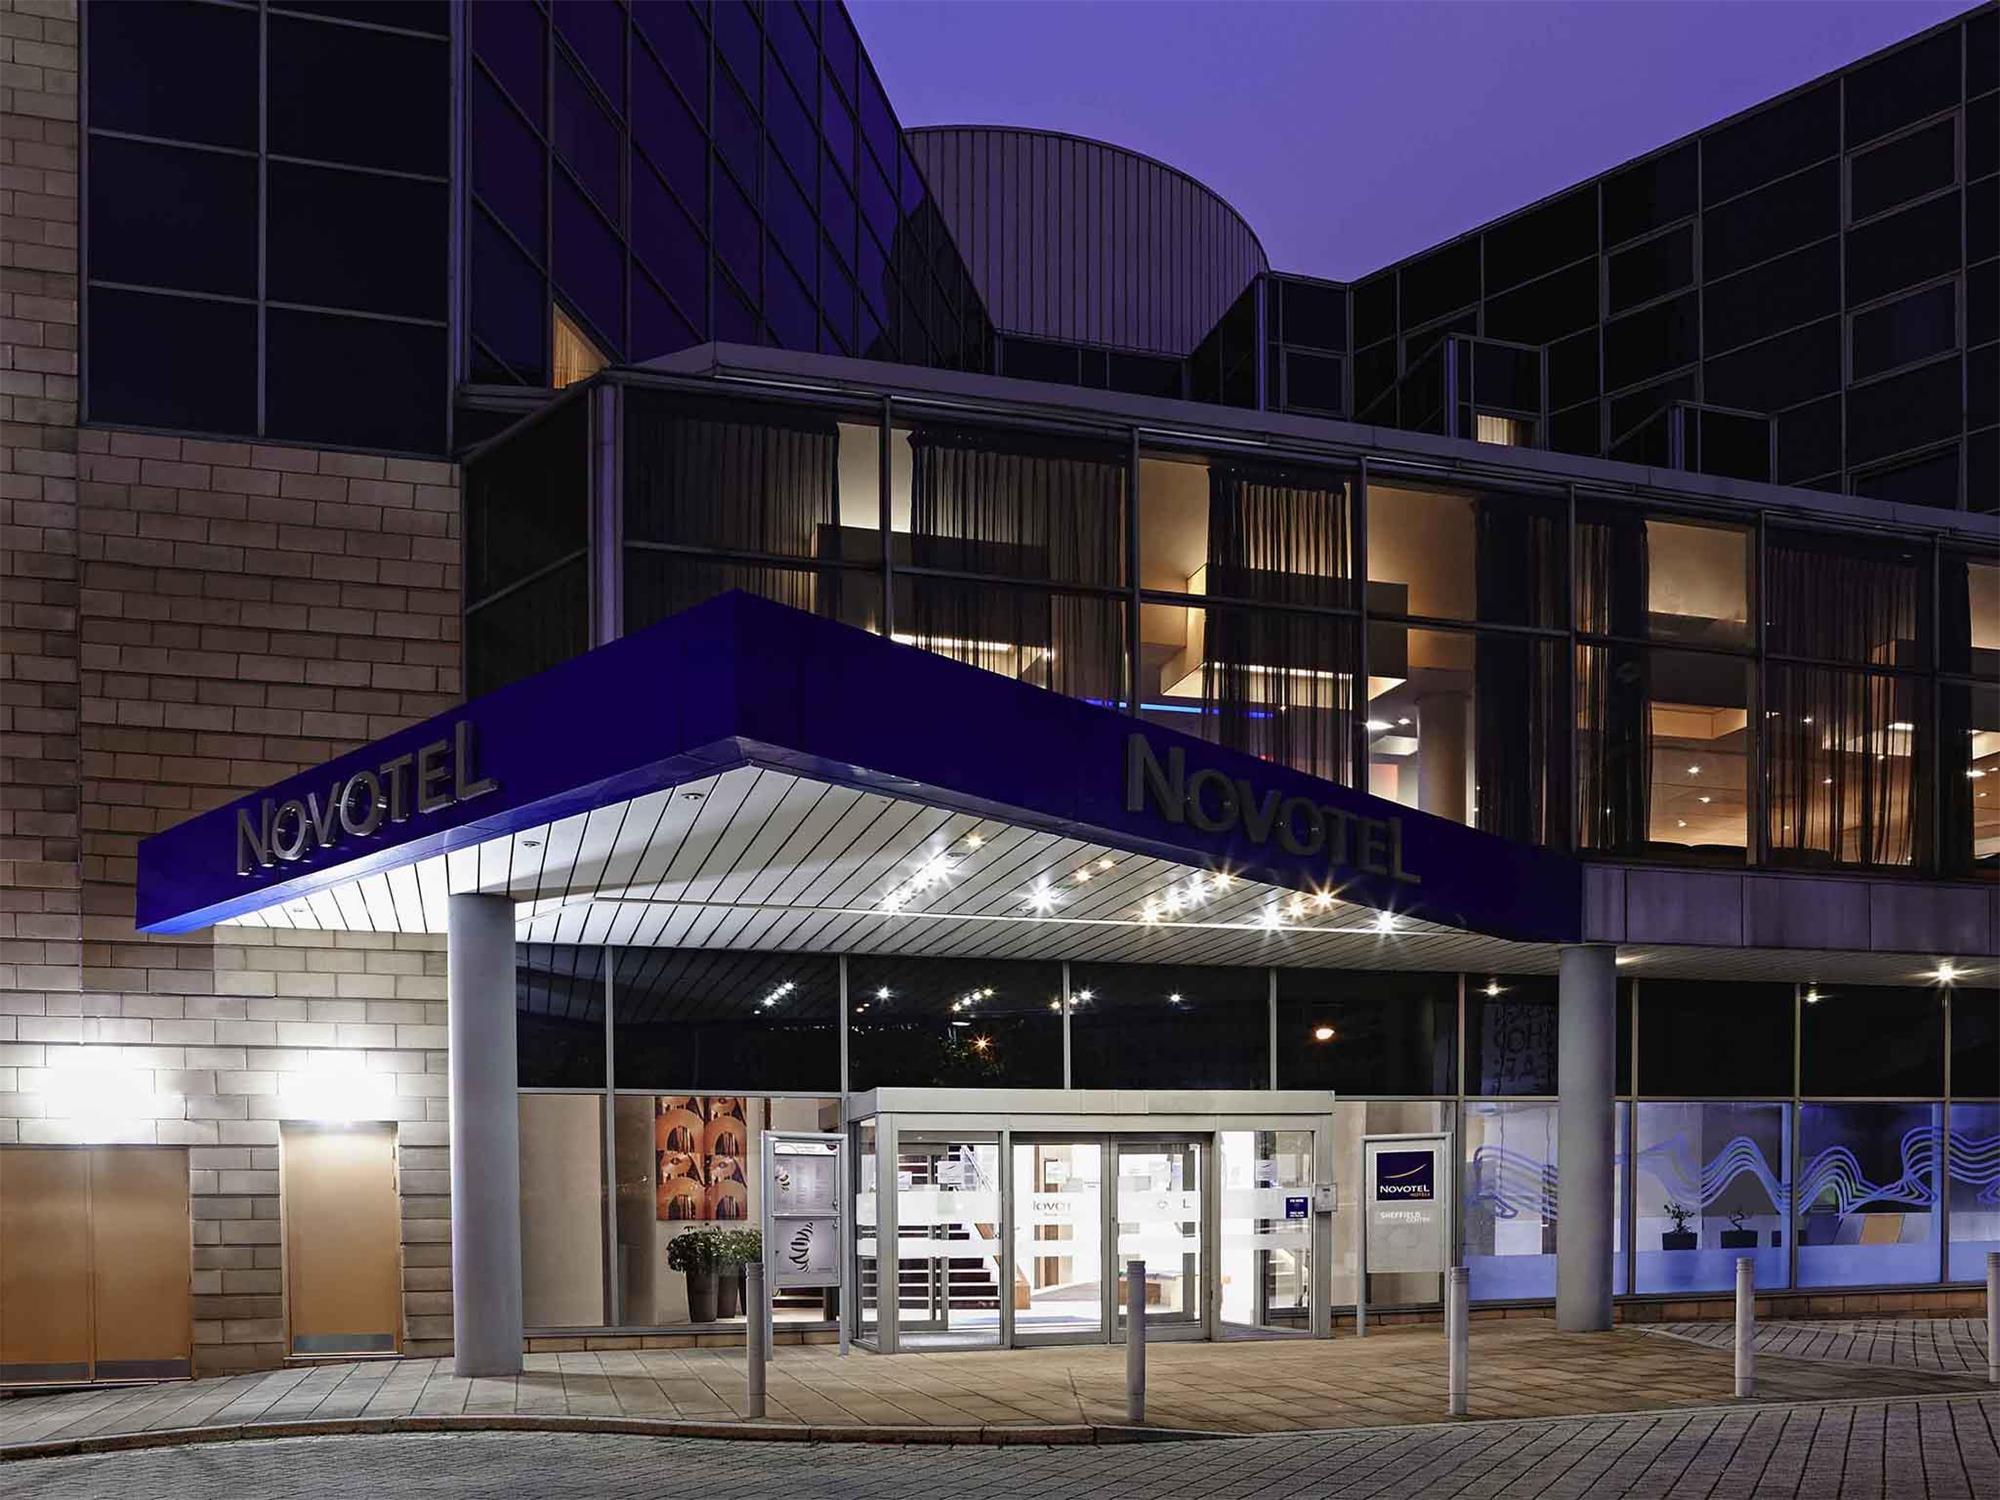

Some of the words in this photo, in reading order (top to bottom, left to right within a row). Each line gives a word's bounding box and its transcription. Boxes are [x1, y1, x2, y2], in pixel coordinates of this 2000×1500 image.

[236, 719, 499, 876] NOVOTEL
[1126, 733, 1421, 884] NOVOTEL
[1380, 1184, 1430, 1193] NOVOTEL
[1380, 1211, 1421, 1219] SHEFFIELD
